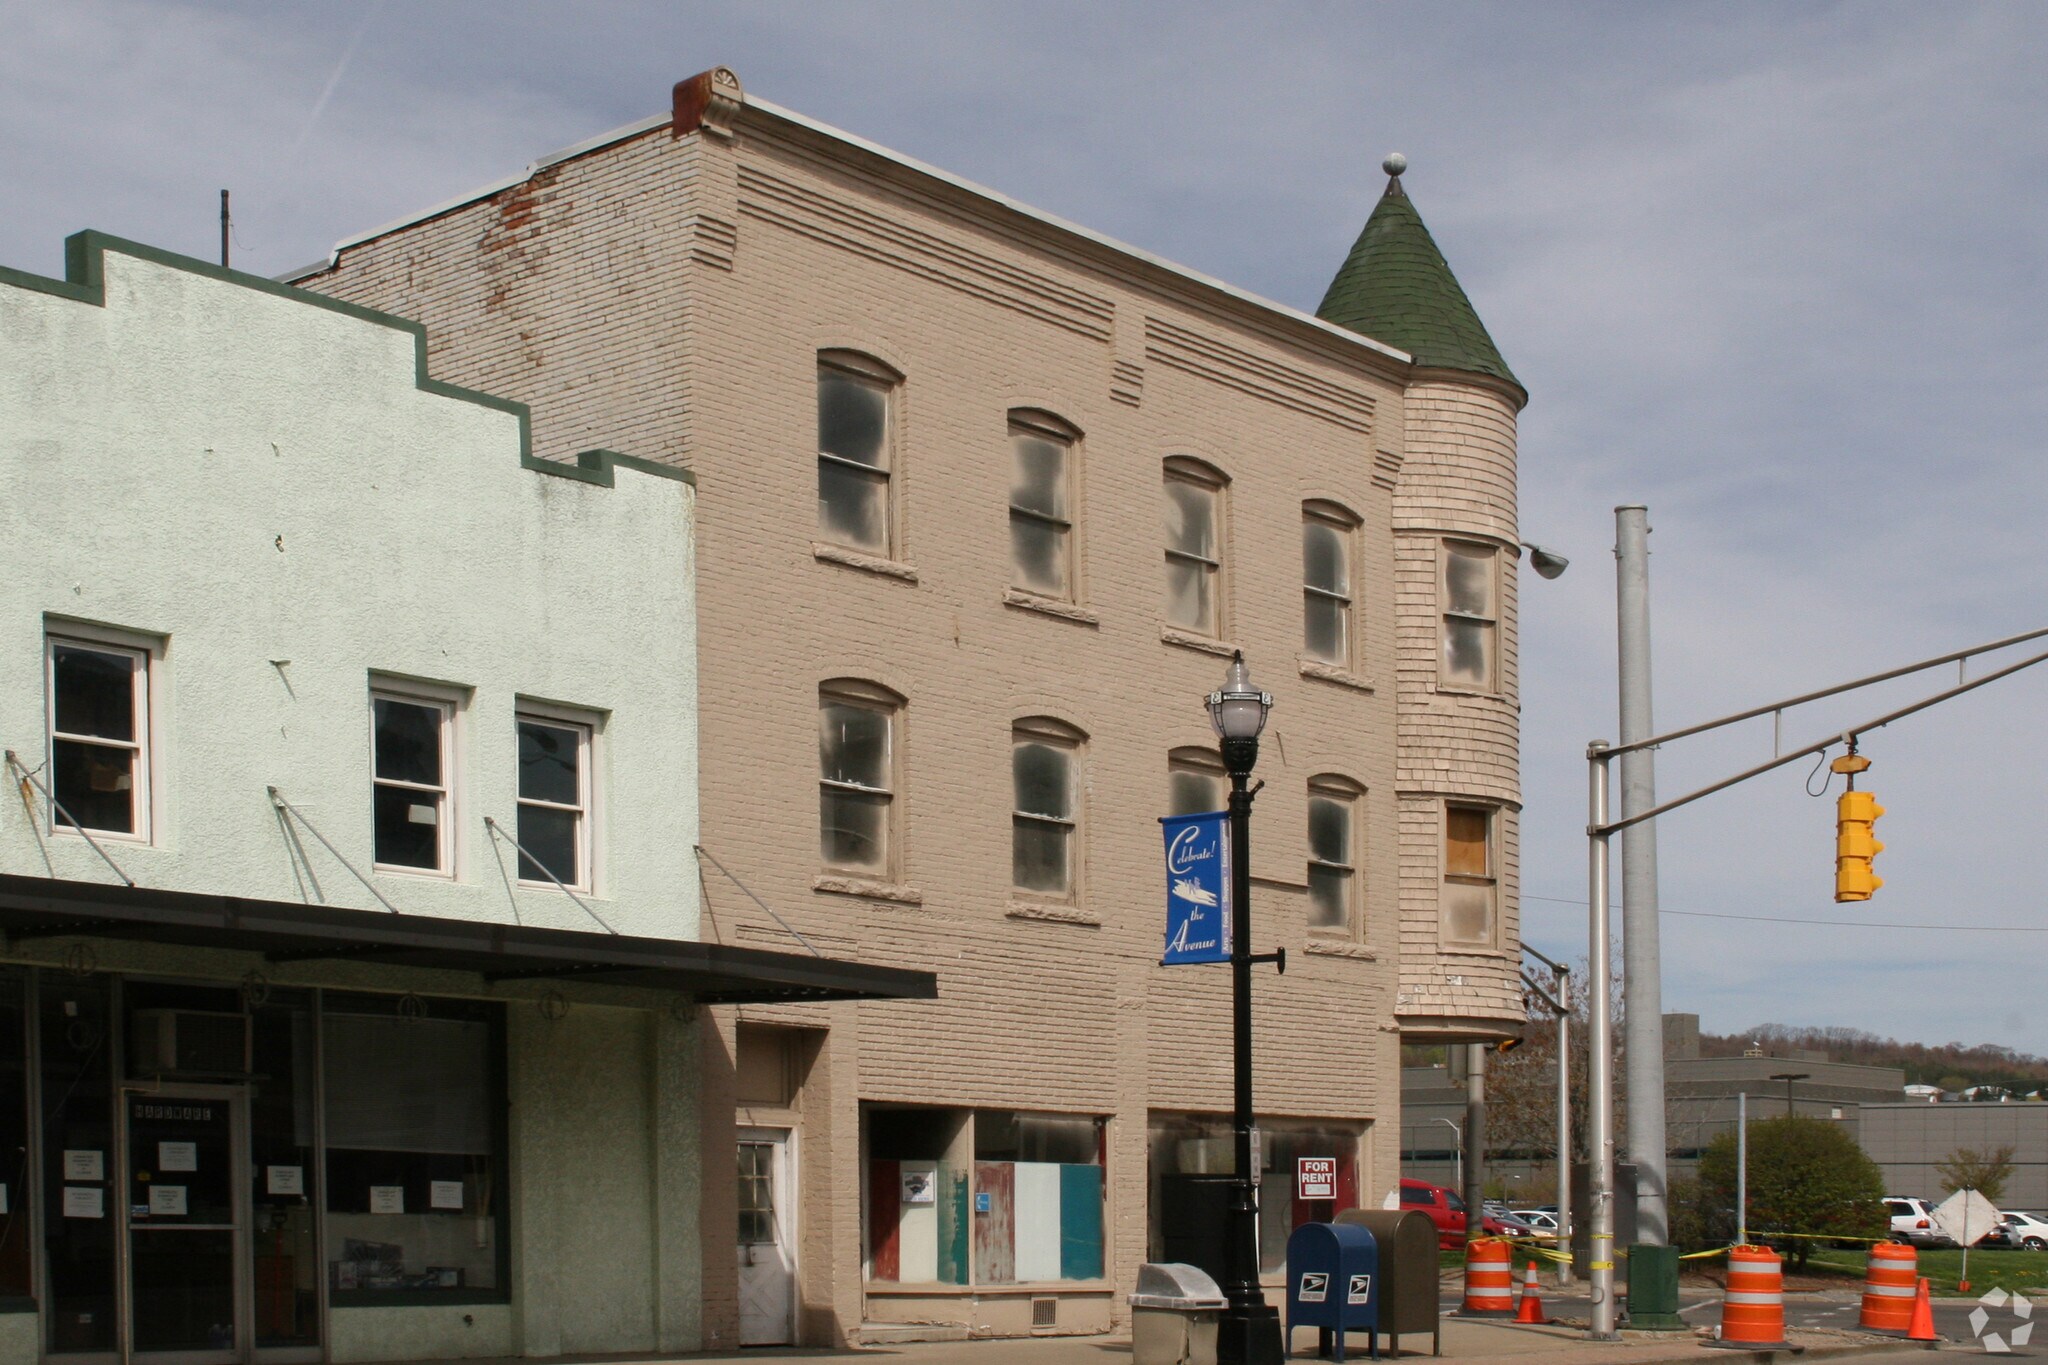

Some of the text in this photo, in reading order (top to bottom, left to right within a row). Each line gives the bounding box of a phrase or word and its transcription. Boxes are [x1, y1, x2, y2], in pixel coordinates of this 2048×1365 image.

[1168, 825, 1216, 875] Celebrate!
[1190, 905, 1204, 921] the
[1165, 919, 1216, 953] Avenue
[134, 1104, 211, 1121] HARDWARE
[1305, 1161, 1329, 1172] FOR
[1301, 1173, 1333, 1183] RENT
